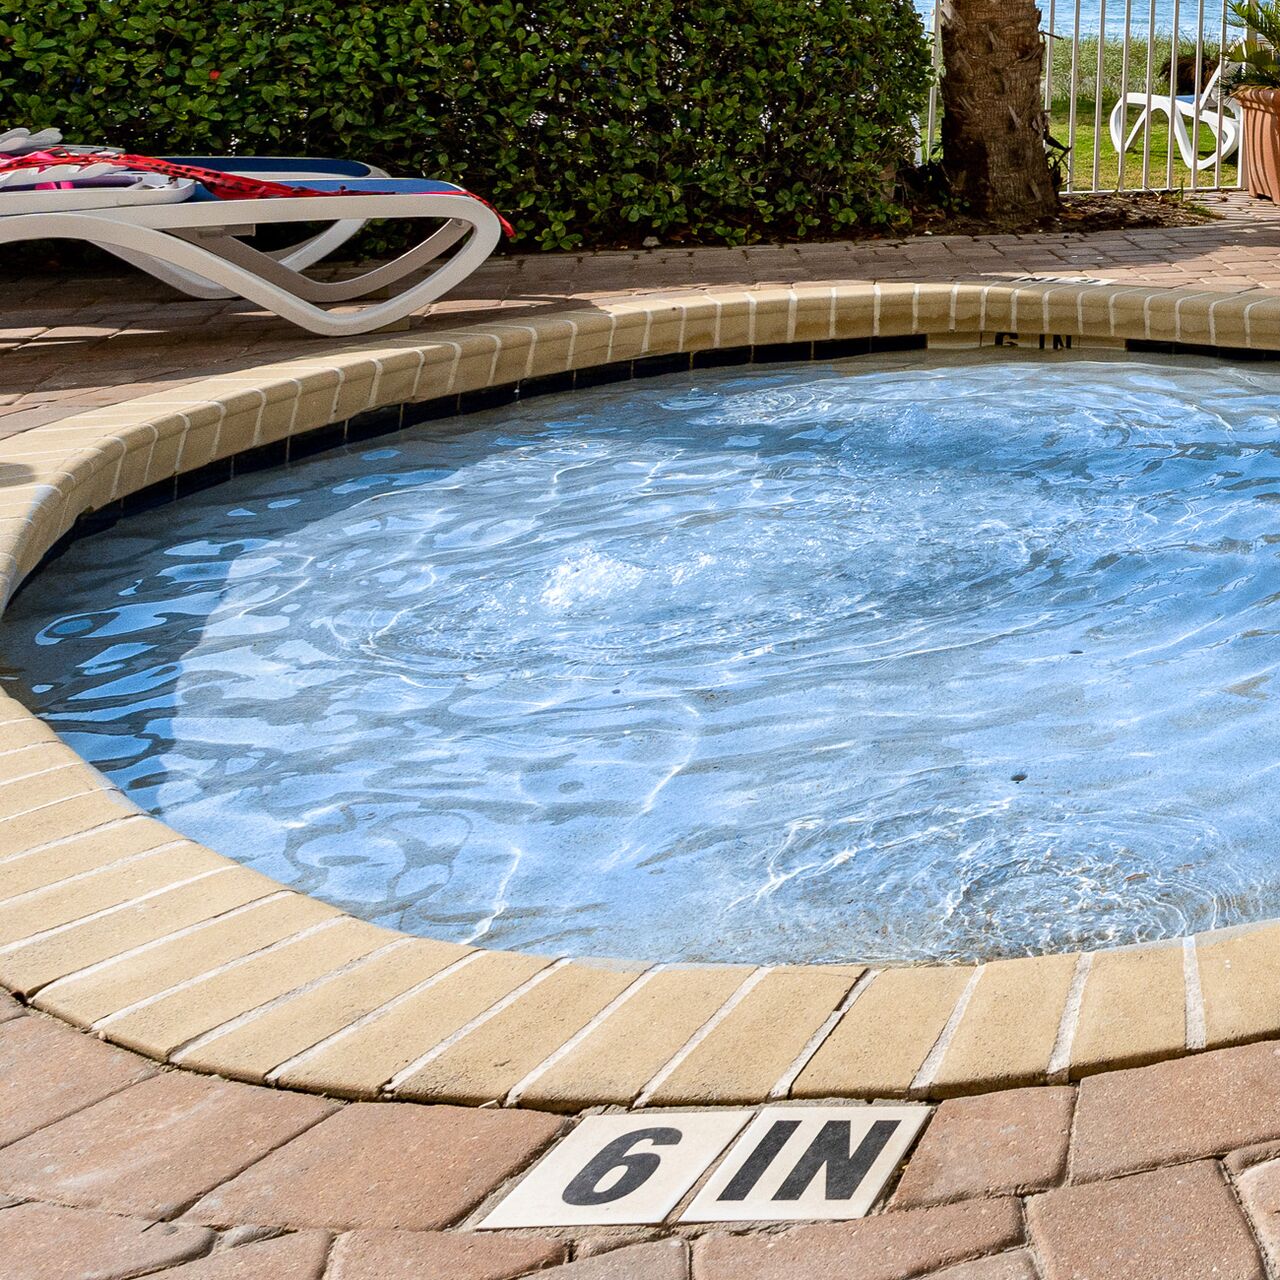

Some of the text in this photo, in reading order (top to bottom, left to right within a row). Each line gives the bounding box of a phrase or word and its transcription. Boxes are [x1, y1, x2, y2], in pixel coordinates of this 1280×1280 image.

[1039, 333, 1072, 349] IN
[562, 1120, 901, 1206] 6 IN
